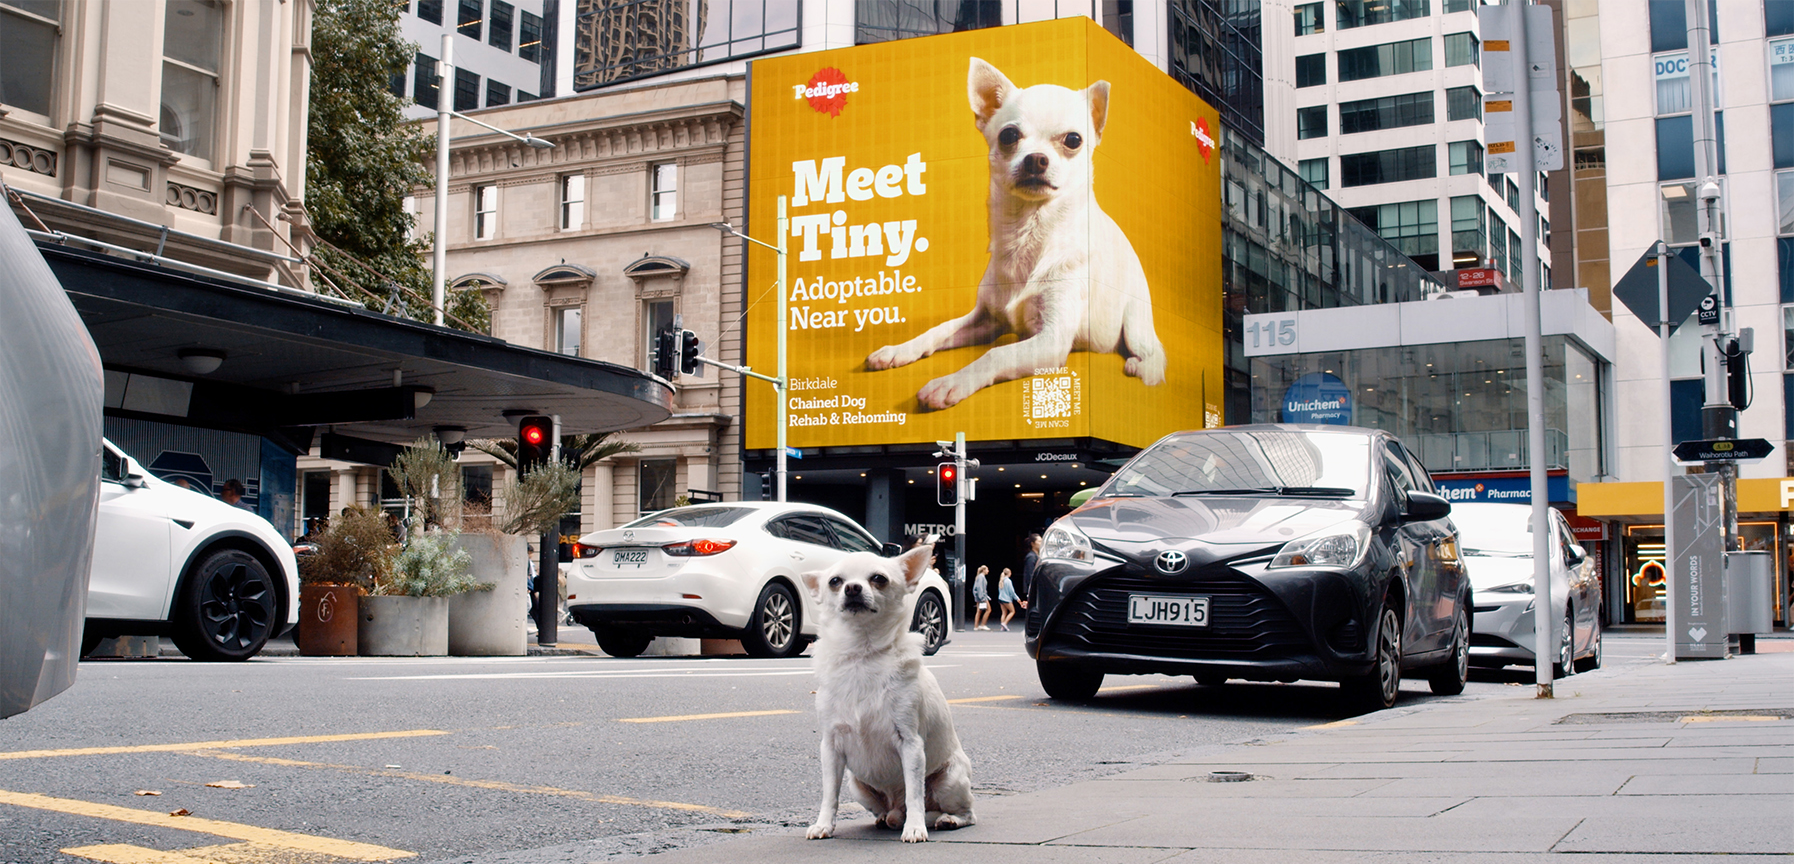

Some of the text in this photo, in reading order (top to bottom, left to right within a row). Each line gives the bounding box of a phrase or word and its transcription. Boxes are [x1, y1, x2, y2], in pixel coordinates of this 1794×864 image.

[1655, 55, 1717, 76] DOCR
[793, 82, 859, 99] Pedigree
[792, 152, 926, 207] Meet
[791, 210, 929, 267] Tiny.
[790, 270, 922, 304] Adoptable.
[790, 306, 906, 332] Near you.
[1700, 310, 1716, 318] CCTV
[1246, 320, 1296, 348] 115
[790, 377, 838, 391] Birkdale
[1023, 381, 1030, 393] ME
[789, 395, 866, 410] Chained Dog
[1073, 378, 1081, 415] MEET ME
[1288, 399, 1340, 412] Unichem
[789, 410, 906, 427] Rehab & Rehoming
[1048, 420, 1069, 428] SCAN
[1035, 453, 1077, 461] JCDecaux
[1487, 489, 1531, 498] Pharmac
[904, 523, 956, 536] METRO
[614, 551, 647, 562] QMA222
[1689, 555, 1698, 584] WORDS
[1690, 584, 1699, 607] YOUR
[1132, 601, 1205, 622] LJH915
[1691, 607, 1699, 616] IN
